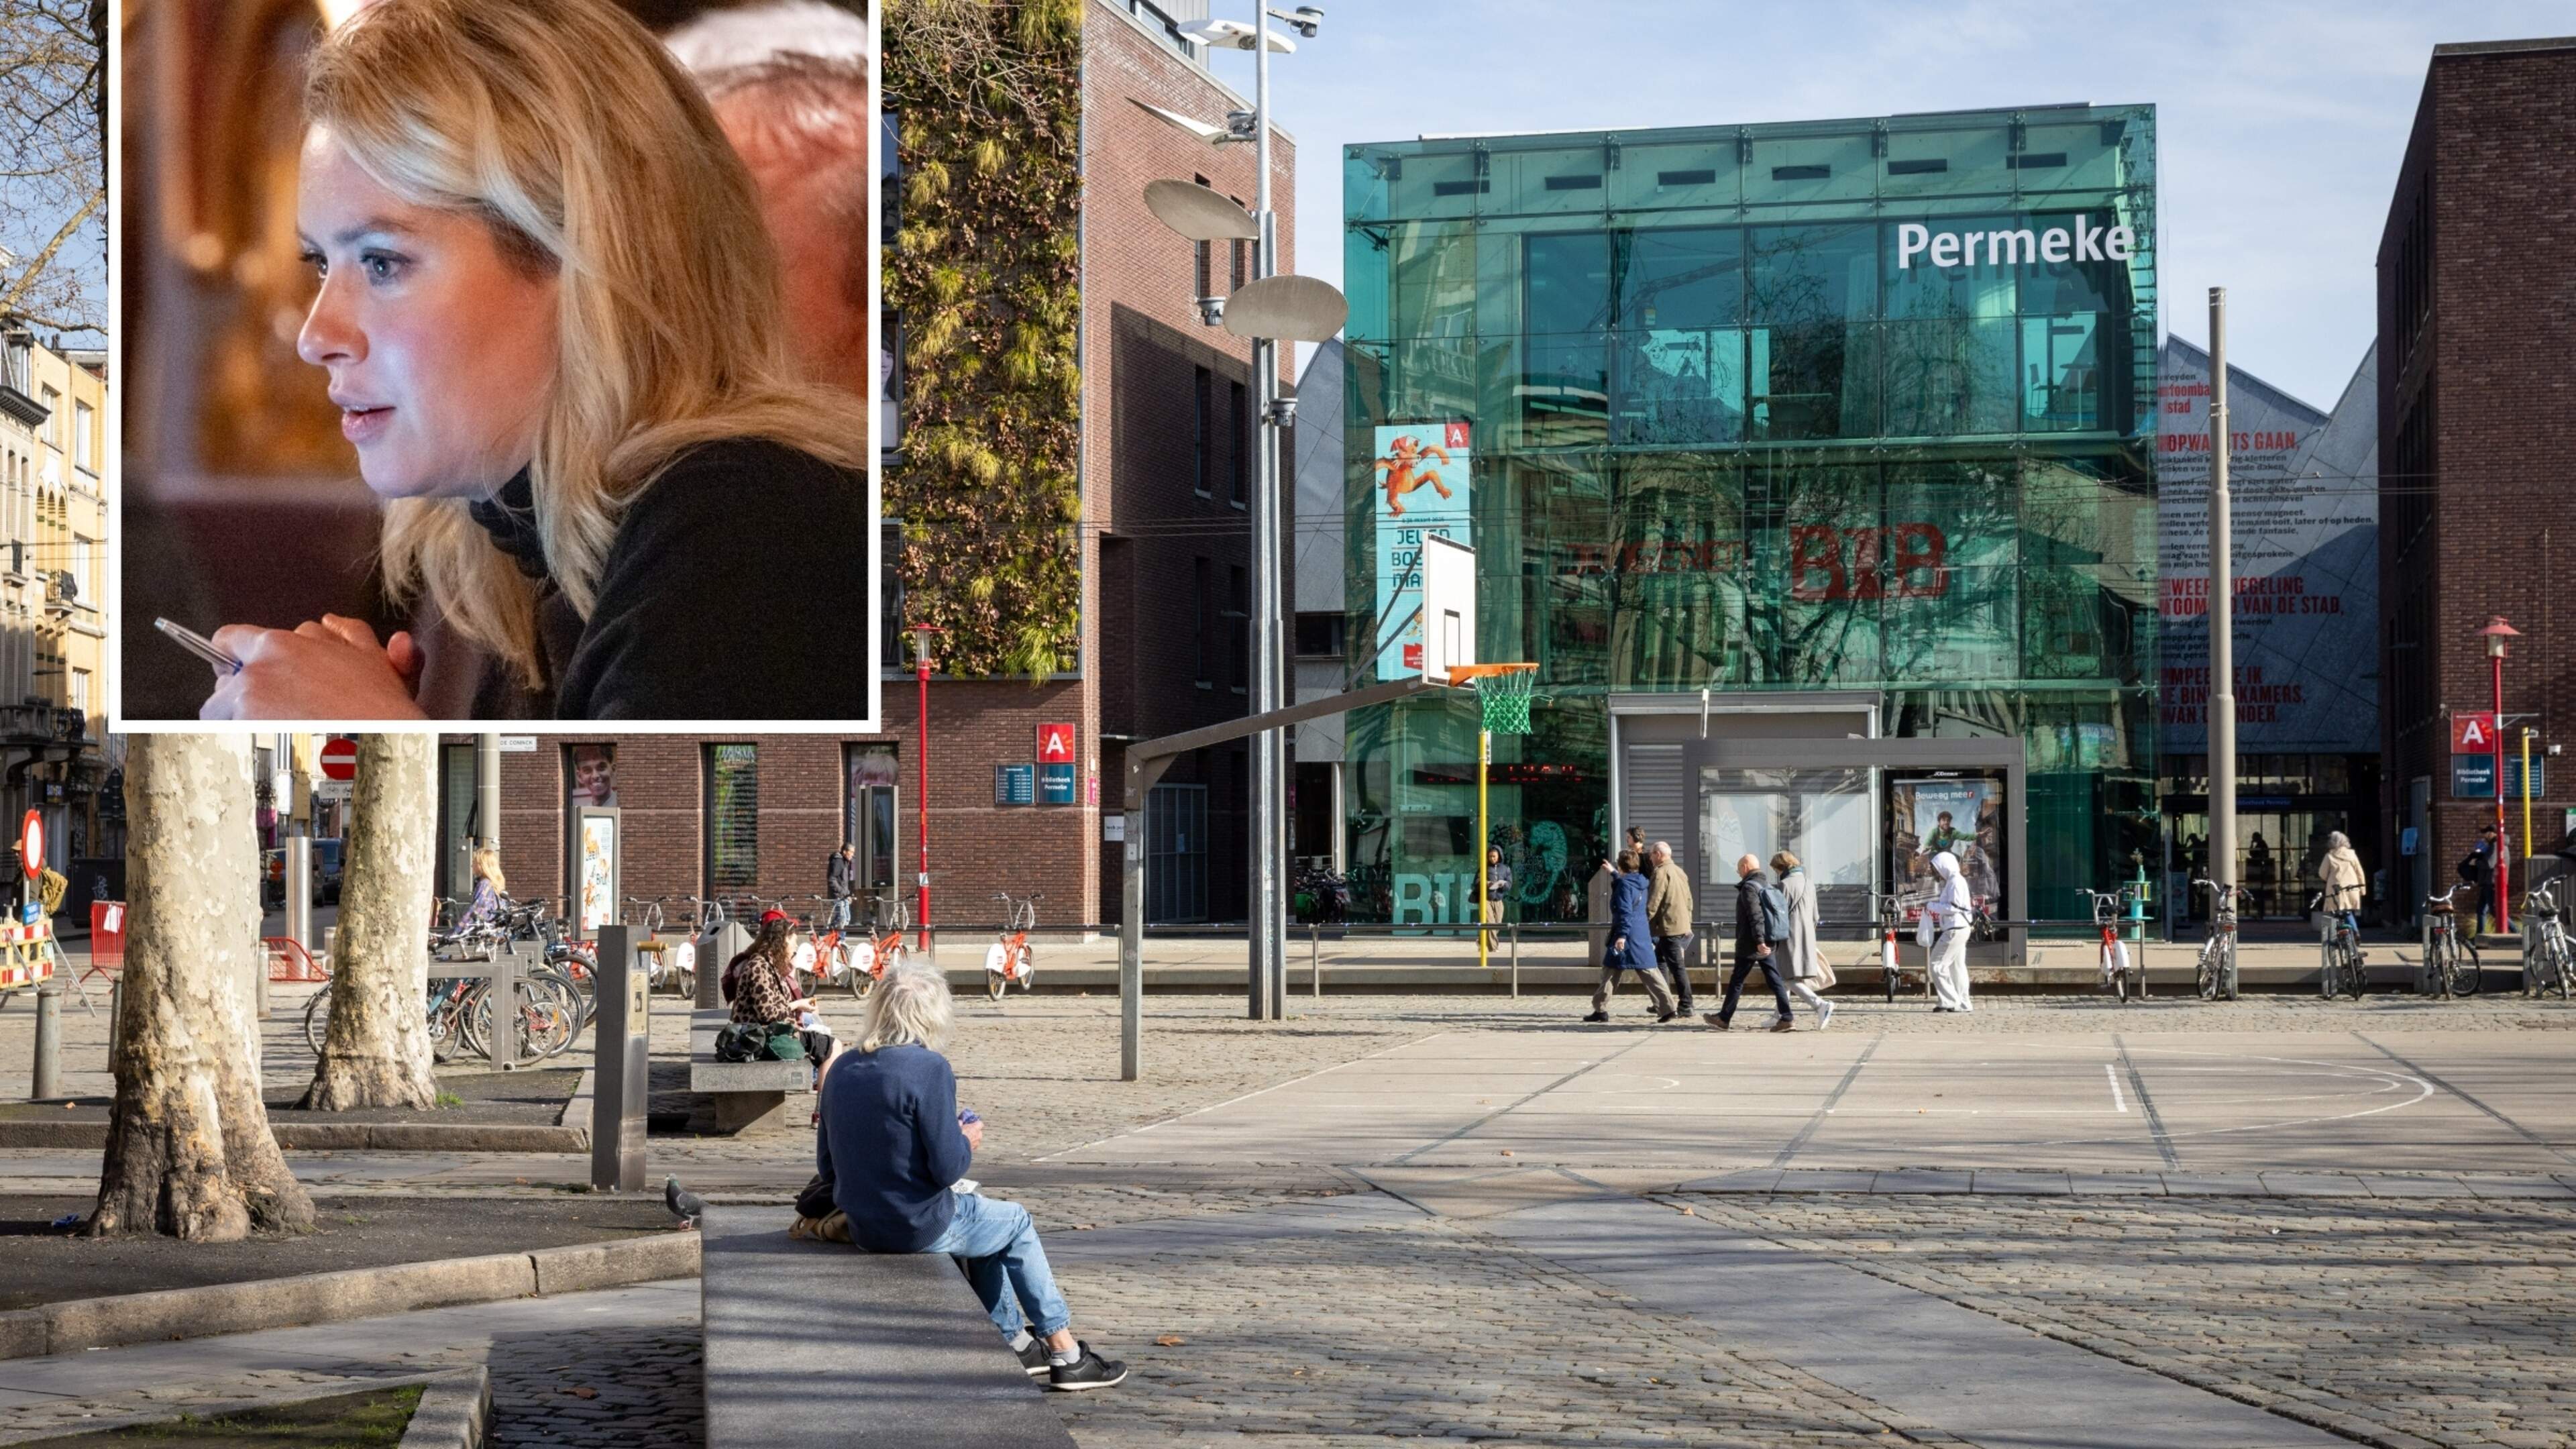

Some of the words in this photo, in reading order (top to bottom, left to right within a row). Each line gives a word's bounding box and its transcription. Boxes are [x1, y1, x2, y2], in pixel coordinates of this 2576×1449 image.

[1898, 215, 2136, 269] Permeke
[2167, 398, 2190, 414] stad
[1451, 428, 1463, 443] A
[2167, 433, 2249, 452] OPWATS
[2255, 431, 2300, 451] GAAN,
[2294, 517, 2316, 525] later
[2344, 516, 2375, 525] heden,
[1791, 523, 1950, 602] BIB
[2243, 597, 2272, 614] VAN
[2277, 597, 2297, 614] DE
[2301, 596, 2345, 616] STAD,
[2462, 720, 2485, 744] A
[1046, 733, 1065, 755] A
[1041, 775, 1071, 784] Bibliotheek
[1915, 792, 1949, 800] Beweeg
